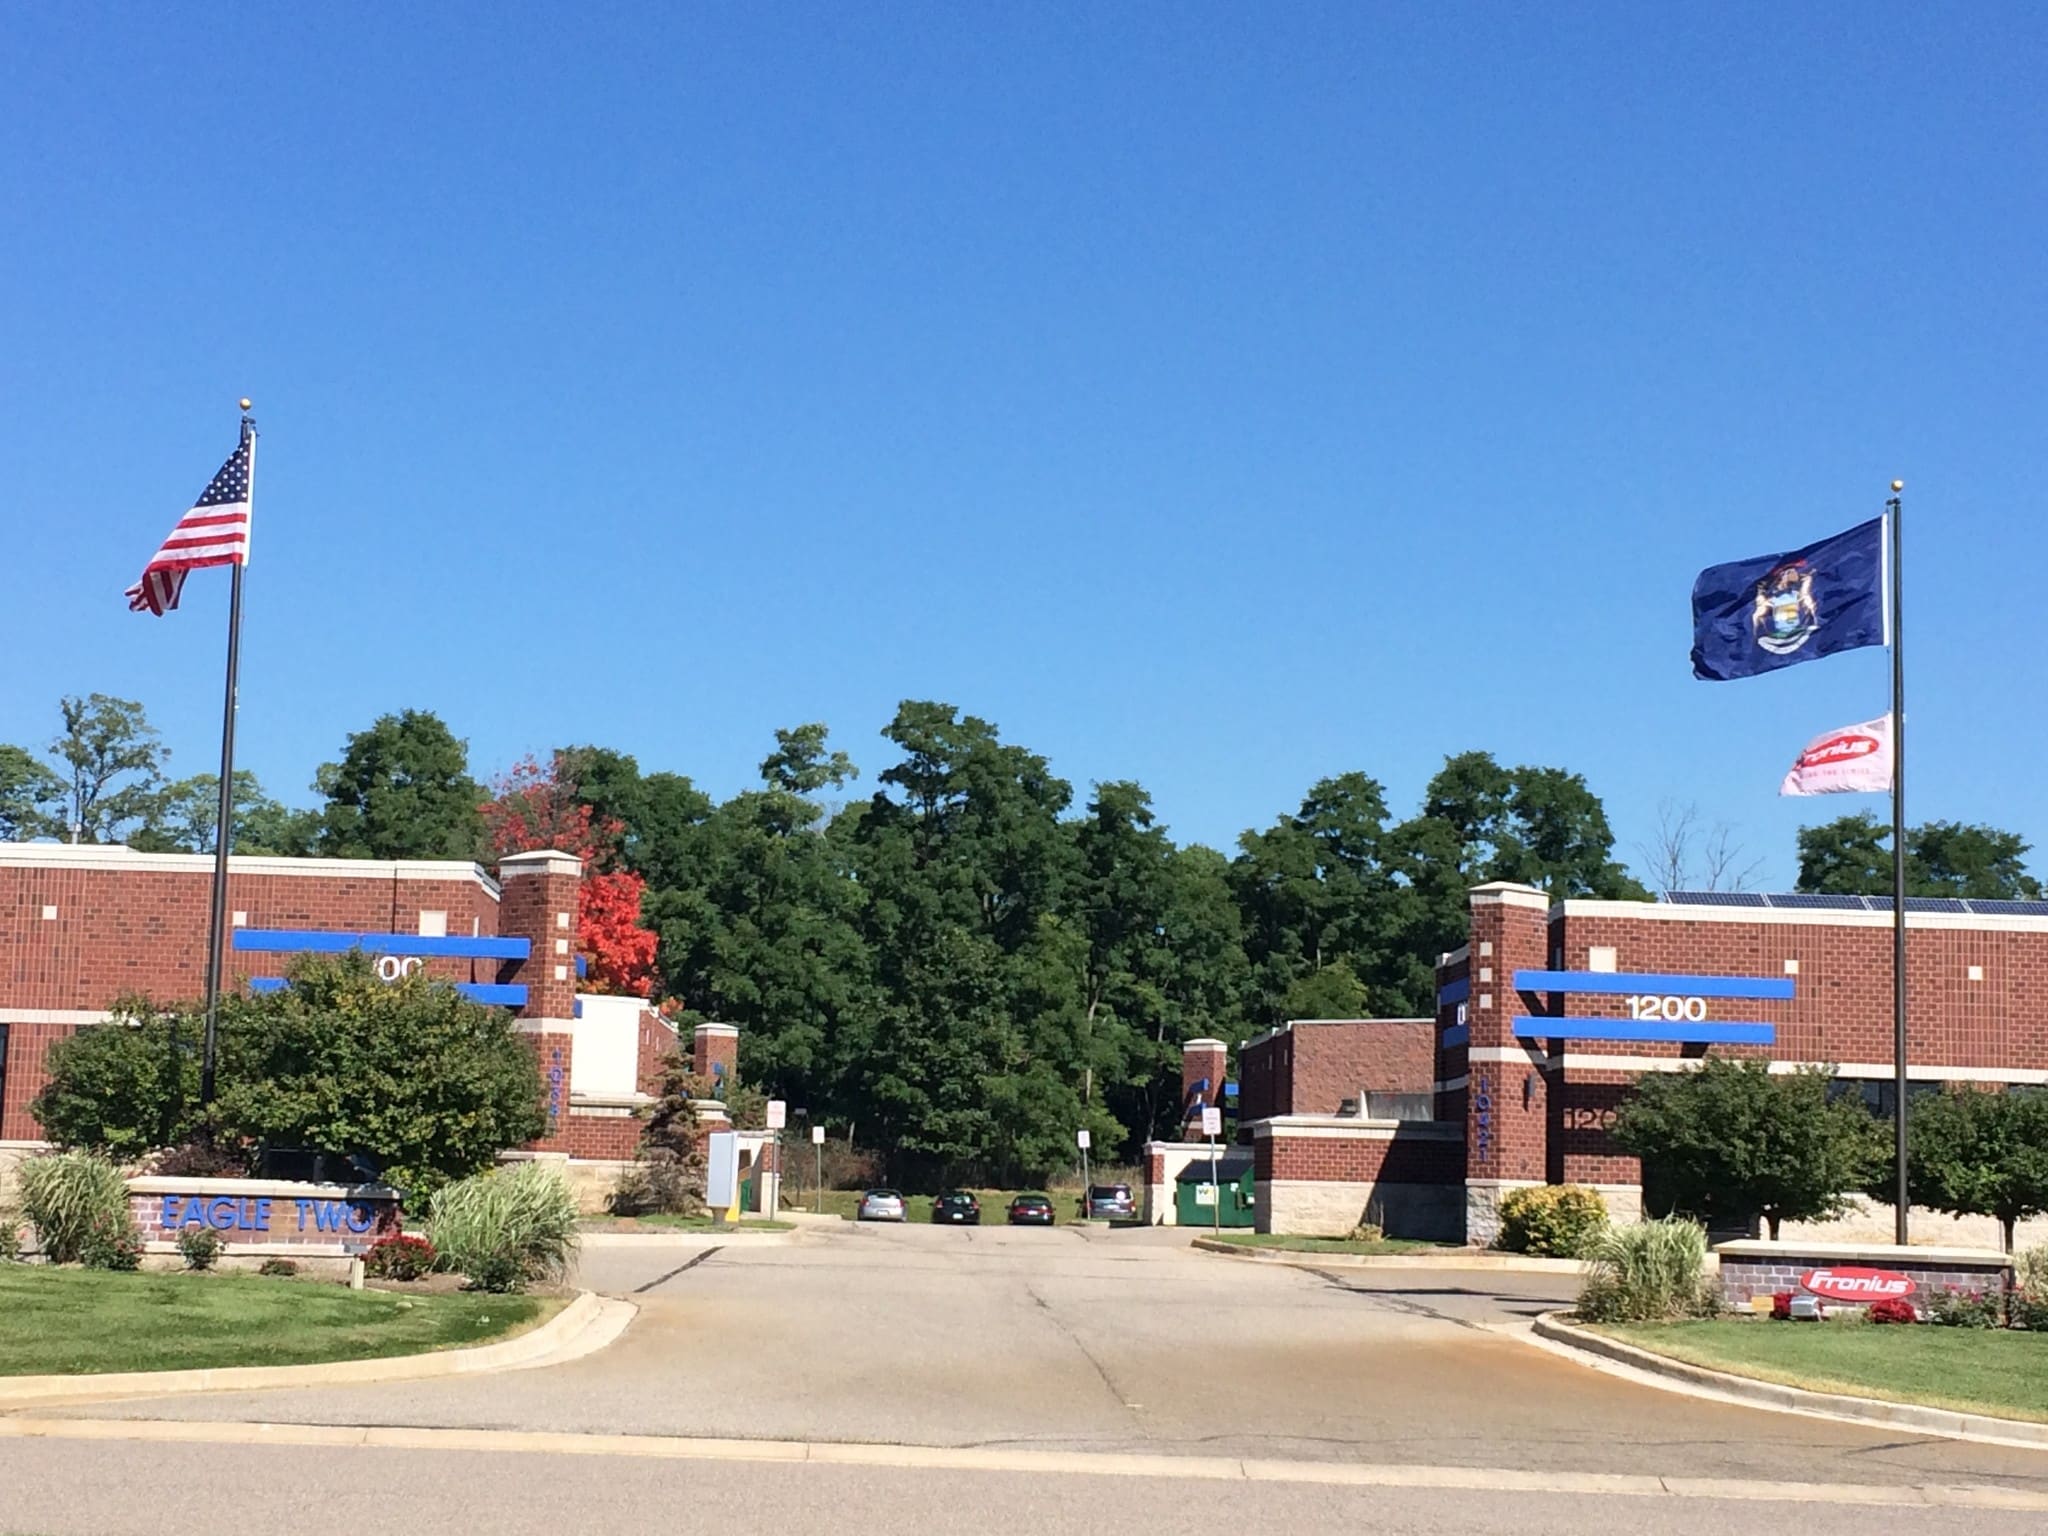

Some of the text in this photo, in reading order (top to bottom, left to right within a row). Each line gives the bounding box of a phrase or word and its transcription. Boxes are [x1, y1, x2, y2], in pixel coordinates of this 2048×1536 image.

[1625, 995, 1707, 1021] 1200
[162, 1196, 374, 1233] EAGLE TWO
[1807, 1271, 1909, 1293] Fronius
